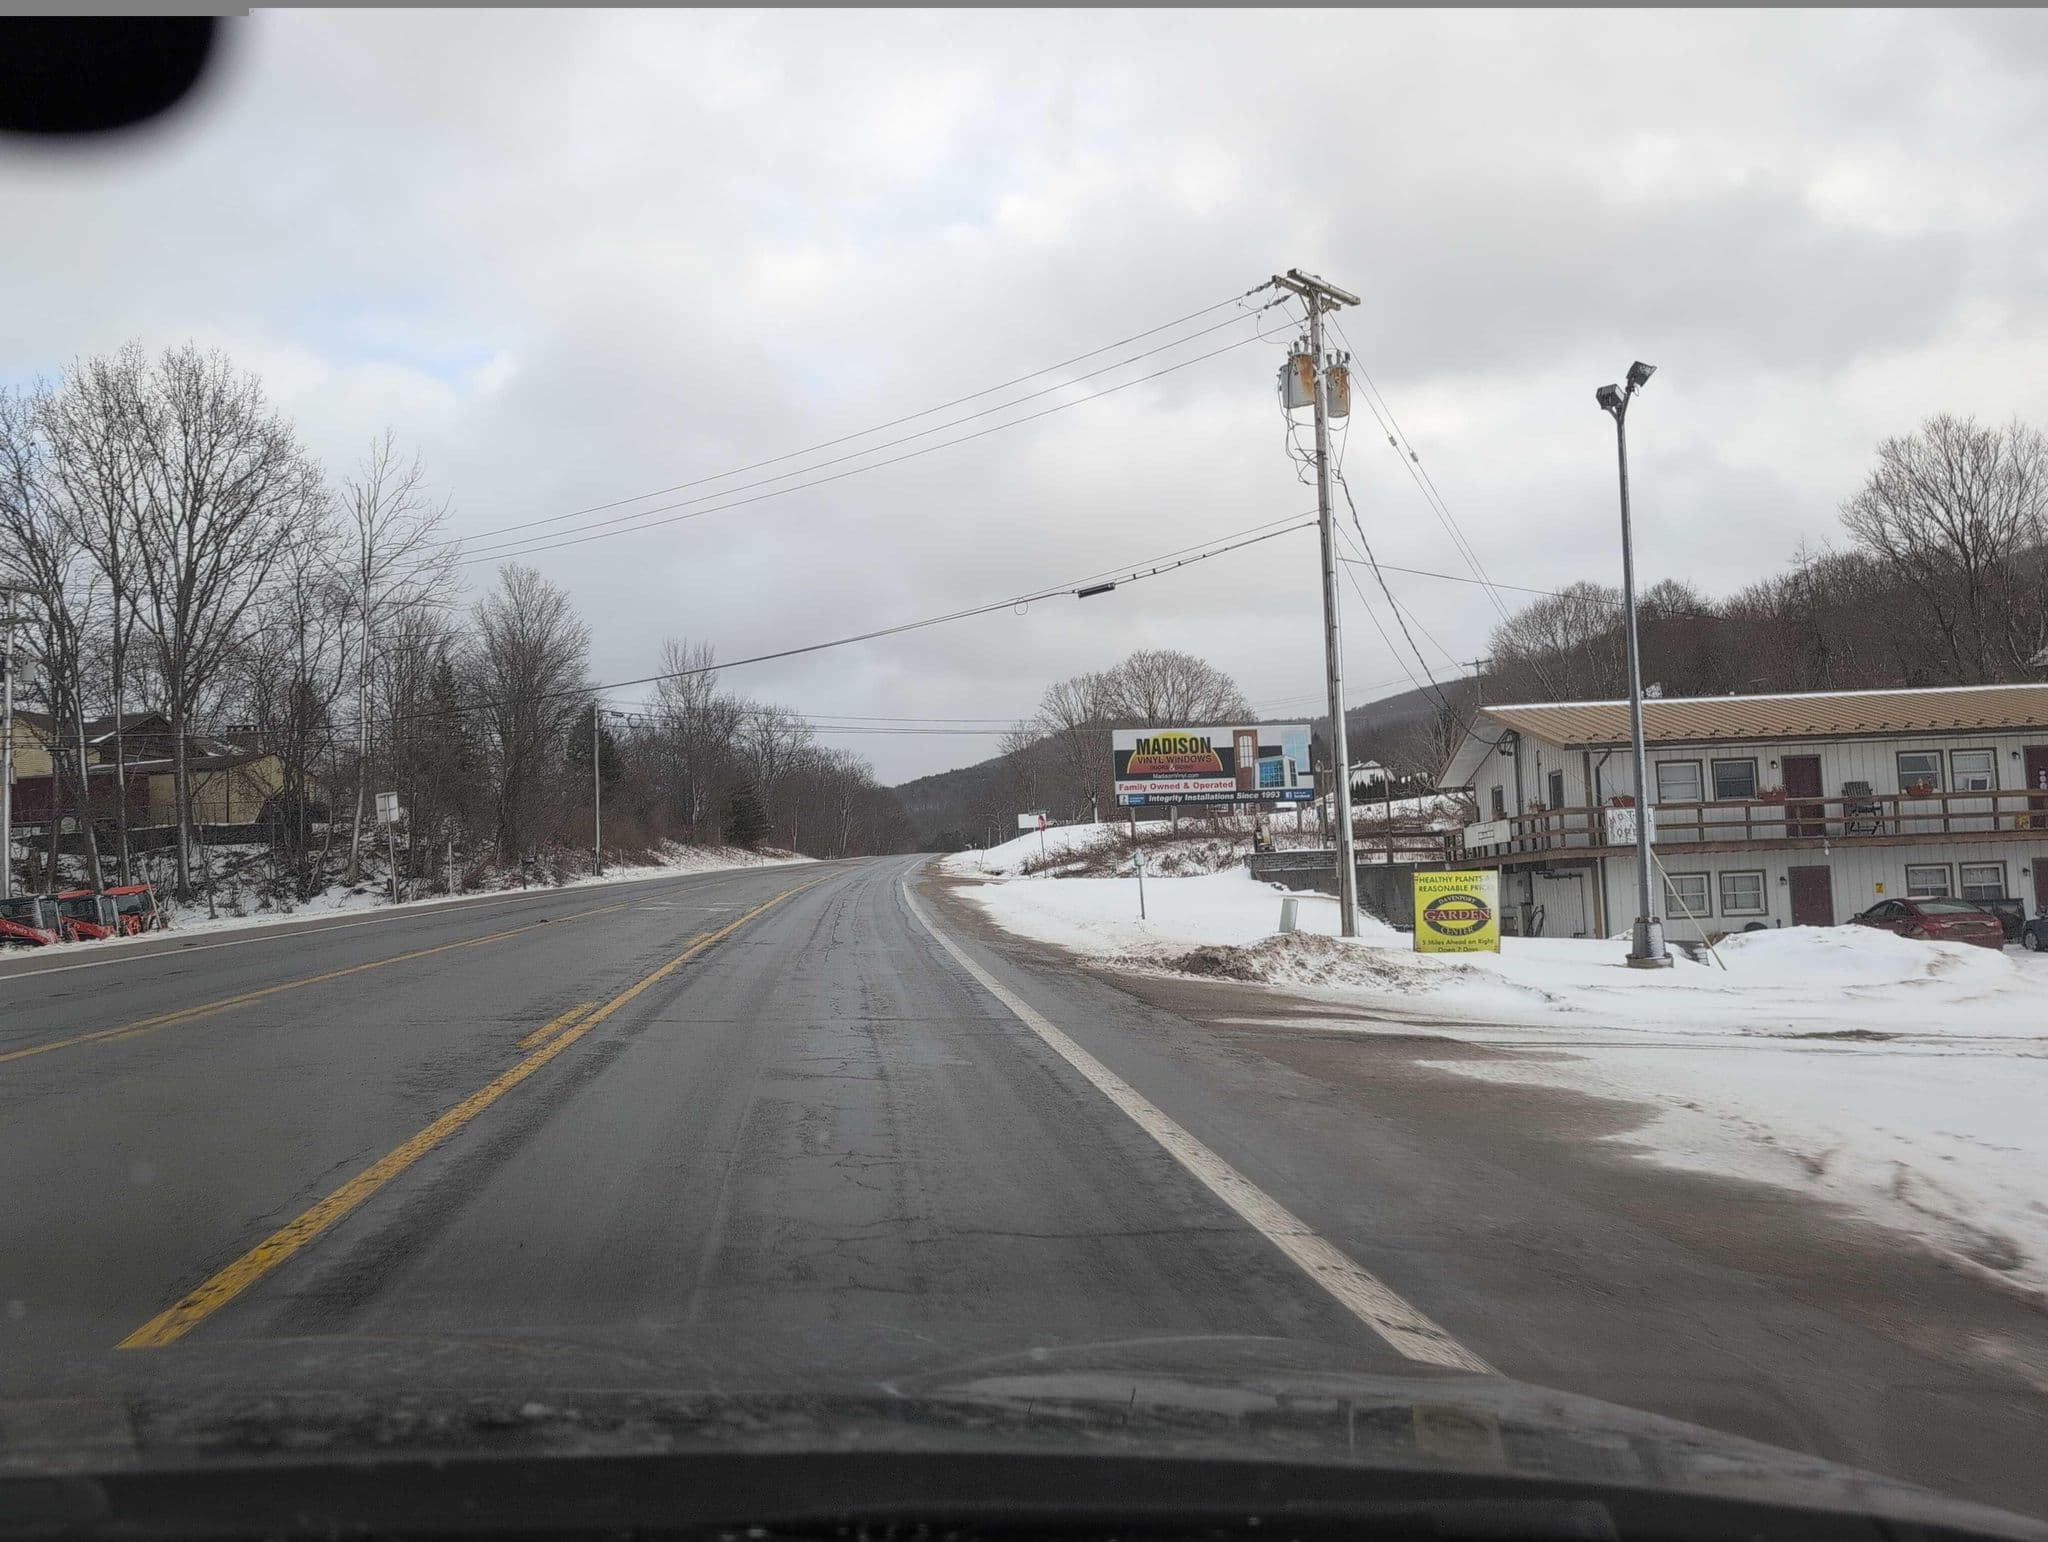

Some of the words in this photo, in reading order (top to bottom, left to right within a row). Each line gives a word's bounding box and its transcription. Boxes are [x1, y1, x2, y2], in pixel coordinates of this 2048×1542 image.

[1136, 737, 1212, 755] MADISON
[1137, 756, 1164, 764] VINYL
[1166, 754, 1212, 763] WINDOWS
[1119, 783, 1147, 792] Family
[1150, 782, 1180, 790] Owned
[1193, 781, 1233, 791] Operated
[1149, 794, 1182, 803] Integrity
[1185, 792, 1234, 801] Installations
[1236, 791, 1259, 799] Since
[1261, 791, 1281, 799] 1993
[1438, 895, 1476, 904] DAVENPORT
[1424, 909, 1491, 920] GARDEN
[1440, 926, 1474, 936] CENTER
[1478, 938, 1494, 946] Right
